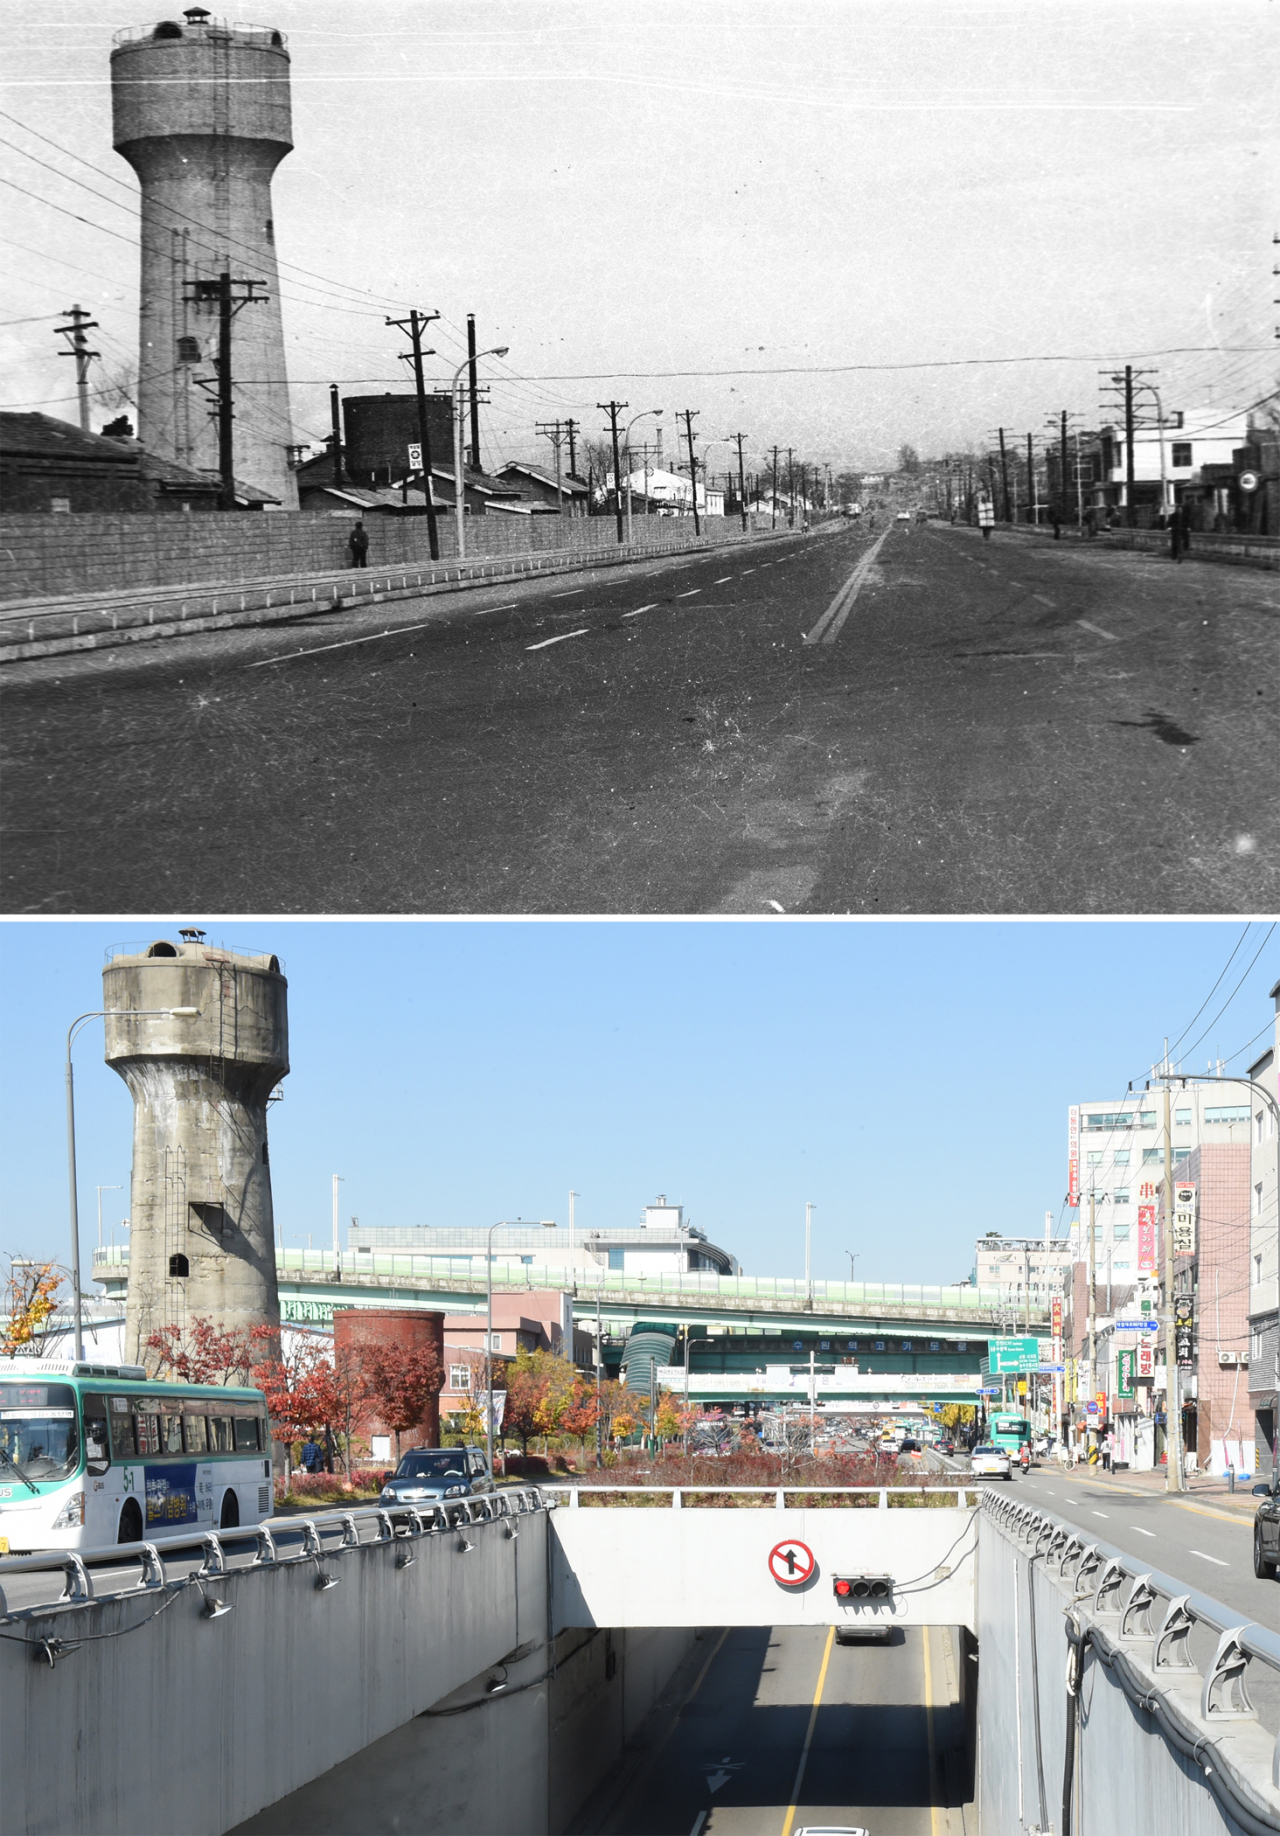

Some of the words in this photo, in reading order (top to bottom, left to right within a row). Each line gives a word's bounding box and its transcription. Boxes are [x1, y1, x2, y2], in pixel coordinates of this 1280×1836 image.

[1140, 1182, 1154, 1198] 串
[1177, 1213, 1193, 1250] 미용실
[124, 1467, 134, 1492] 5-1
